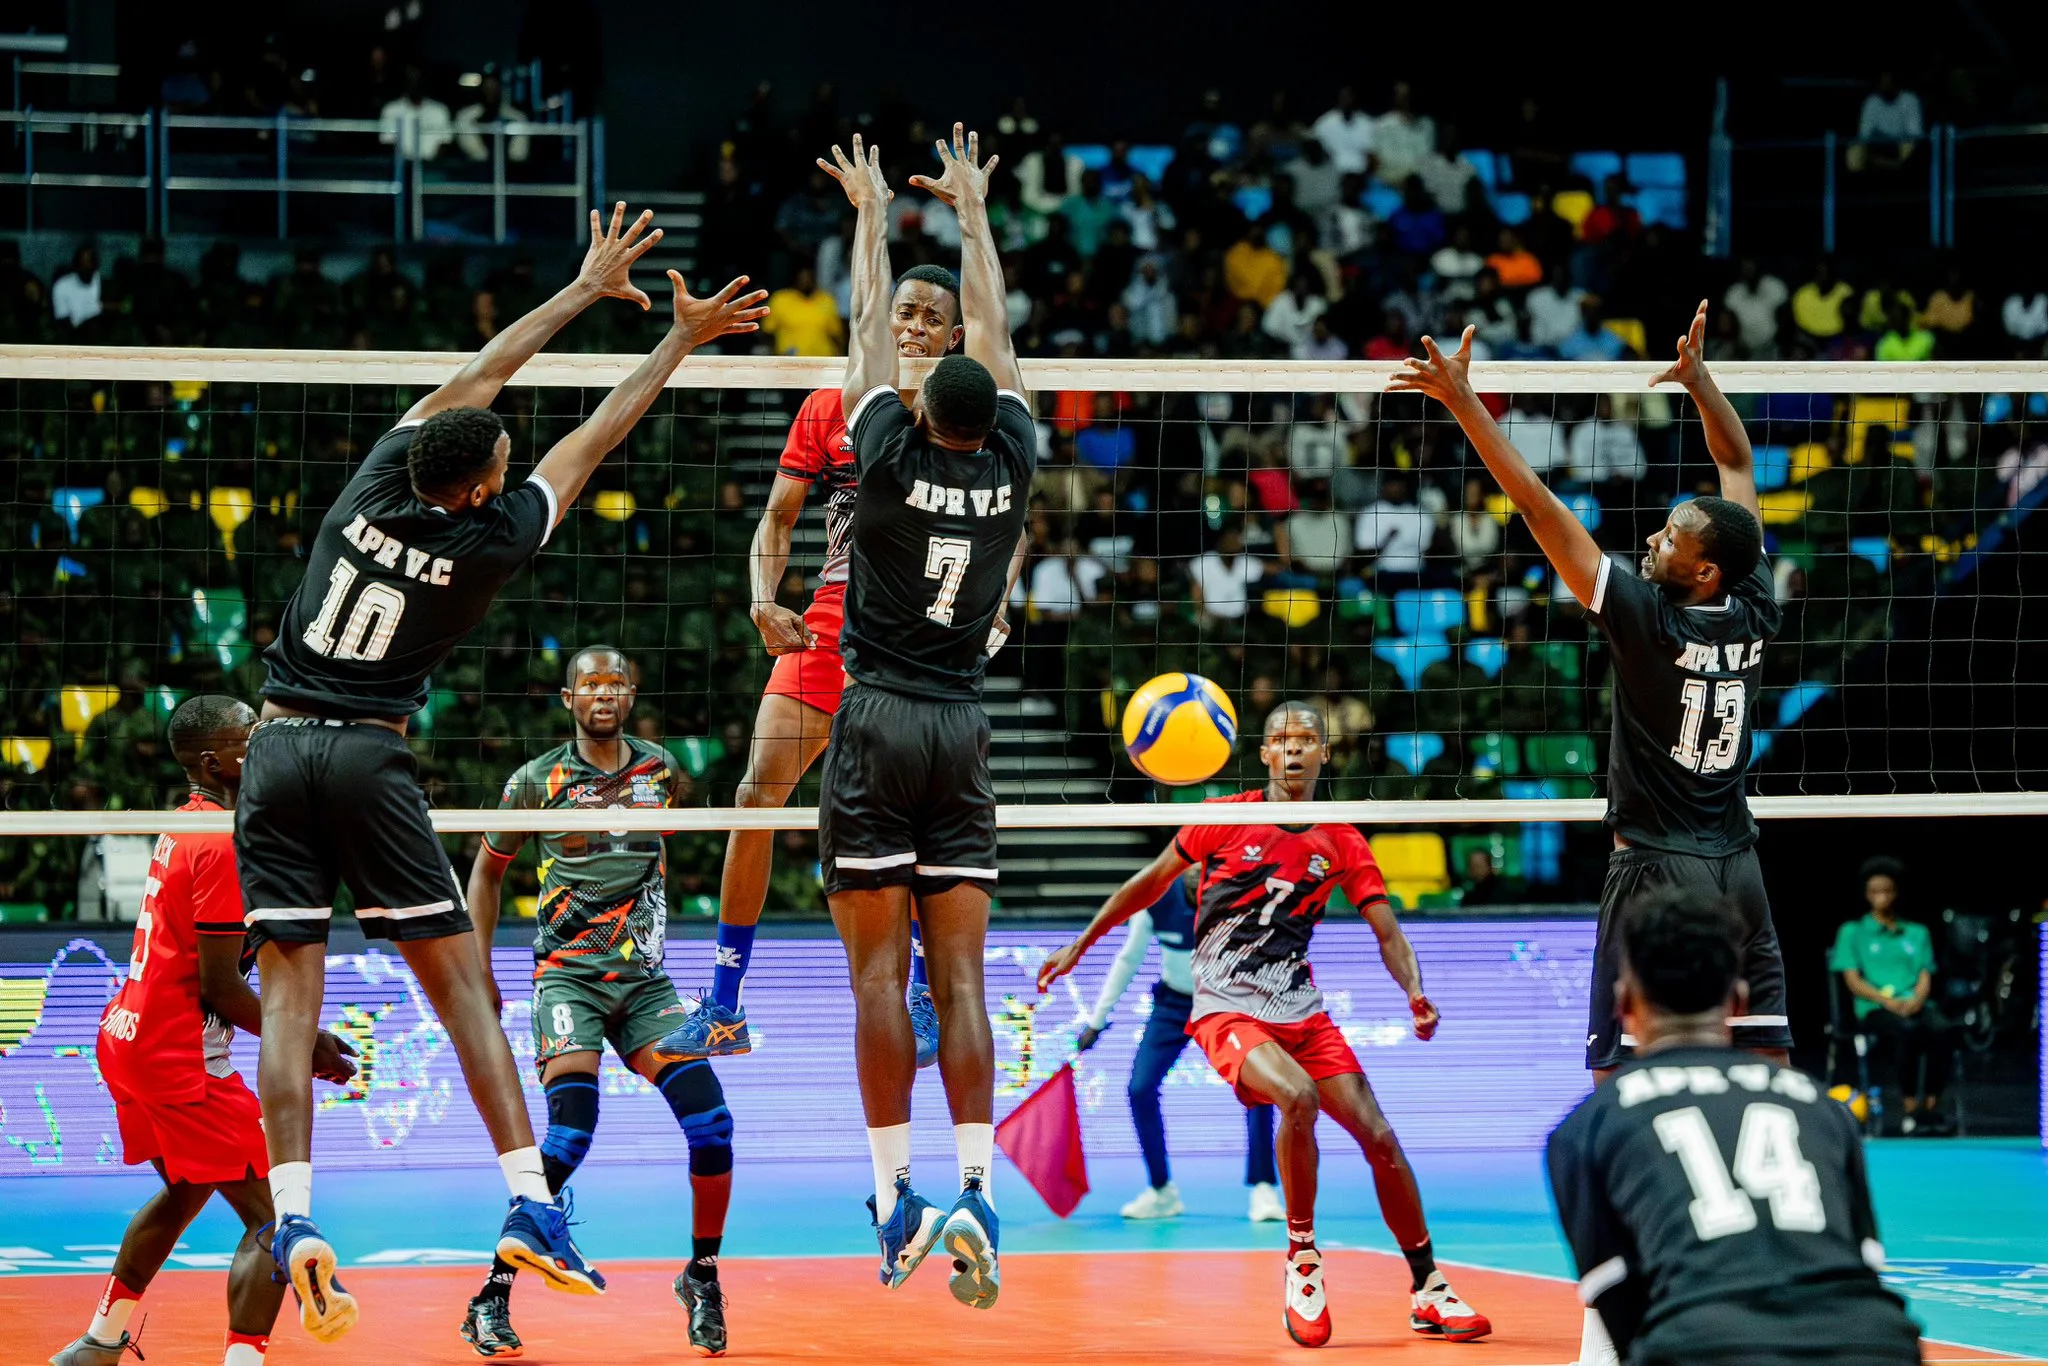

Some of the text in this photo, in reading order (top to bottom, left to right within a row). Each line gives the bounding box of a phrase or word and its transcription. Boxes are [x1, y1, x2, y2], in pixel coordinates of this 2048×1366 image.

[905, 479, 1012, 517] APR V.C
[341, 513, 454, 586] APR V.C
[924, 536, 972, 628] 7
[302, 556, 406, 661] 10
[1674, 638, 1764, 673] APR V.C
[1670, 678, 1746, 774] 13
[1258, 876, 1295, 926] 7
[551, 1003, 575, 1036] 8
[1652, 1102, 1827, 1242] 14
